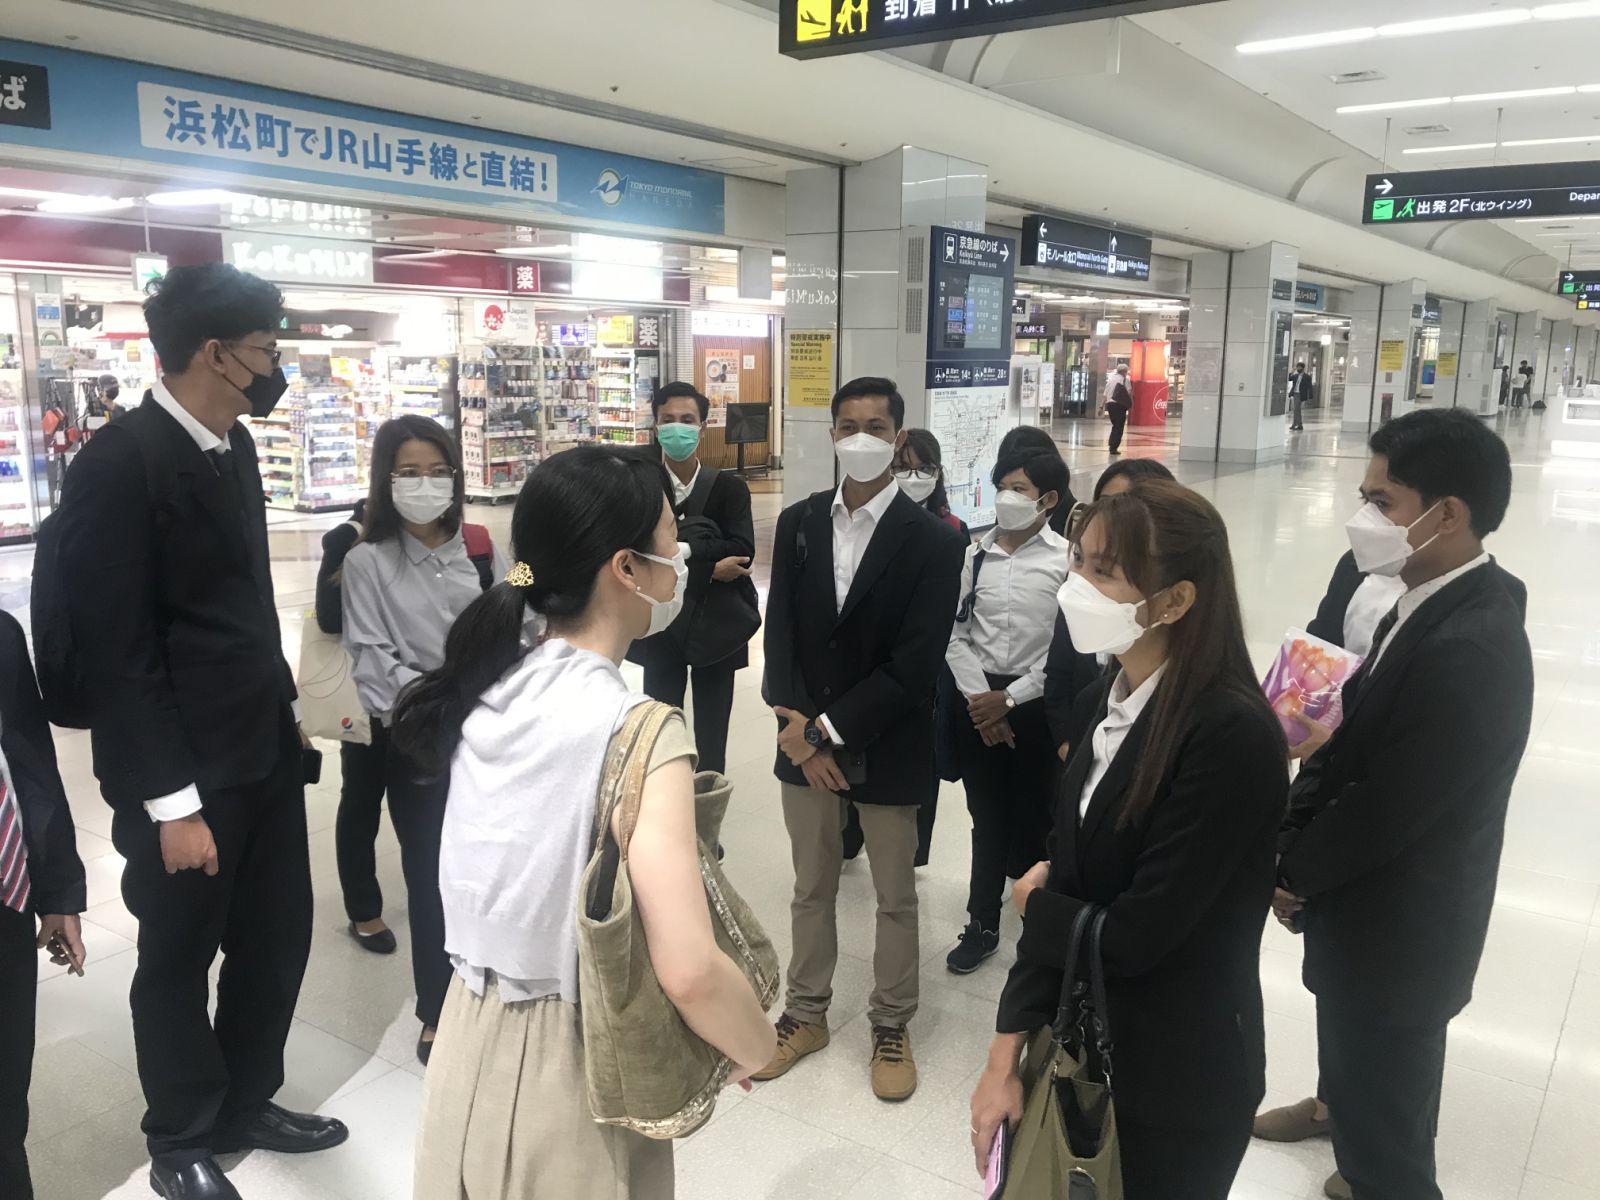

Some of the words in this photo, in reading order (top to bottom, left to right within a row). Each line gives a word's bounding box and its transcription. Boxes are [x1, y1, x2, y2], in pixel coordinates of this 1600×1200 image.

[162, 95, 548, 193] 浜松町でJR山手線と直結!
[516, 265, 534, 290] 薬
[639, 317, 658, 346] 薬
